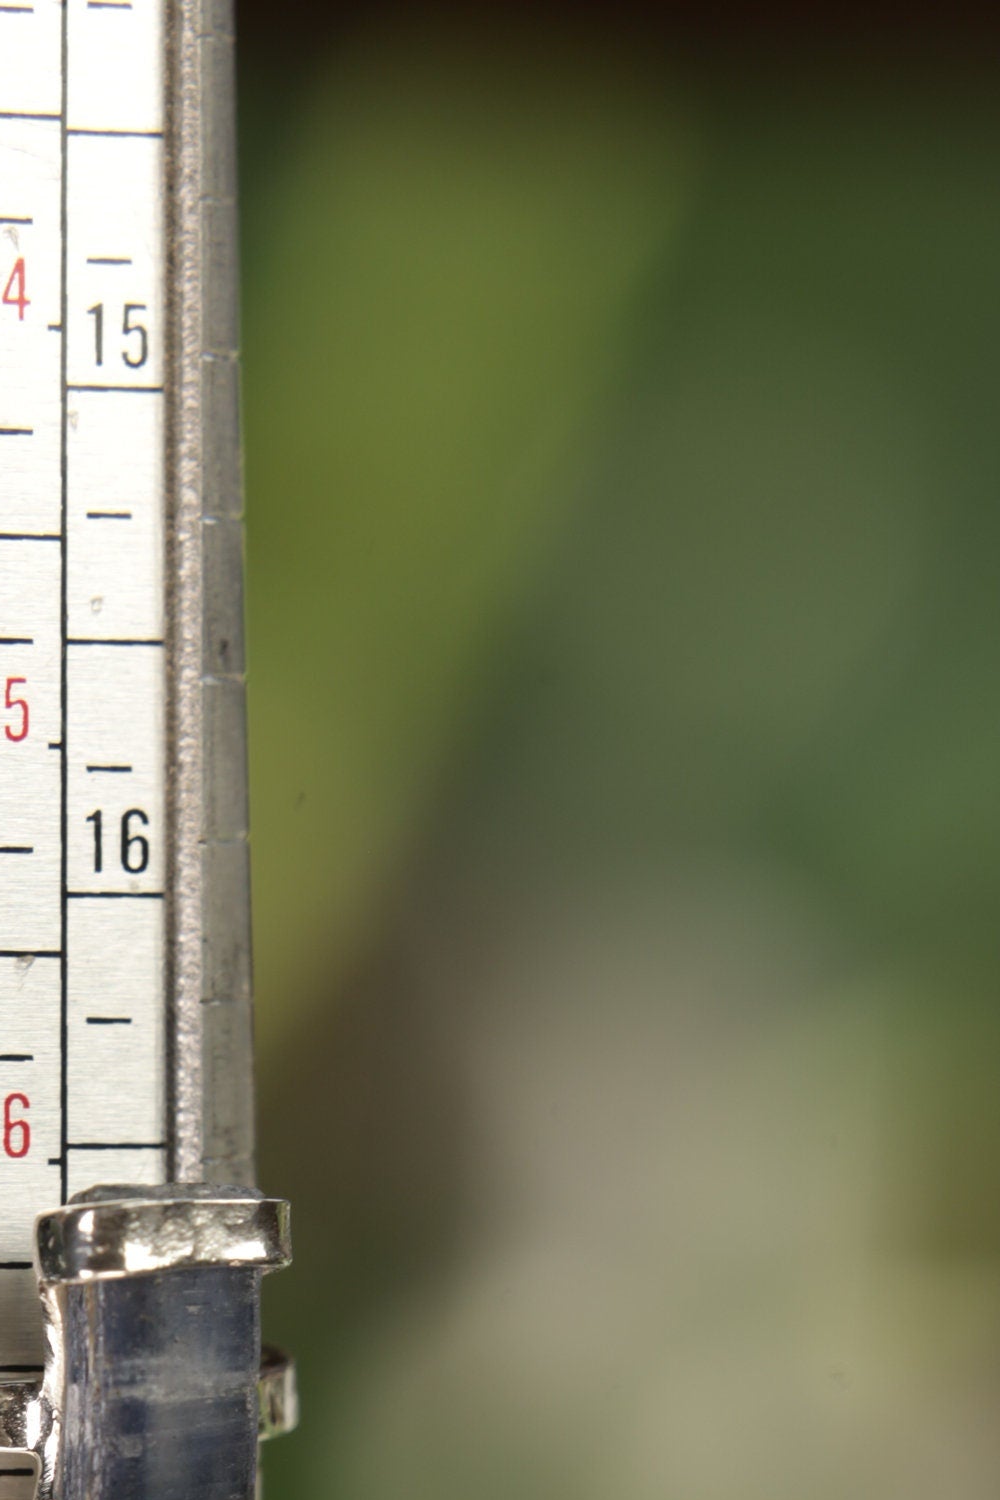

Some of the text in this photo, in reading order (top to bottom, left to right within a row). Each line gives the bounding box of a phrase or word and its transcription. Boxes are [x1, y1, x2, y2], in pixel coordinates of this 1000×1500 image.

[2, 257, 31, 321] 4
[87, 302, 148, 369] 15
[4, 677, 31, 743] 5
[86, 809, 149, 873] 16
[2, 1092, 32, 1159] 6
